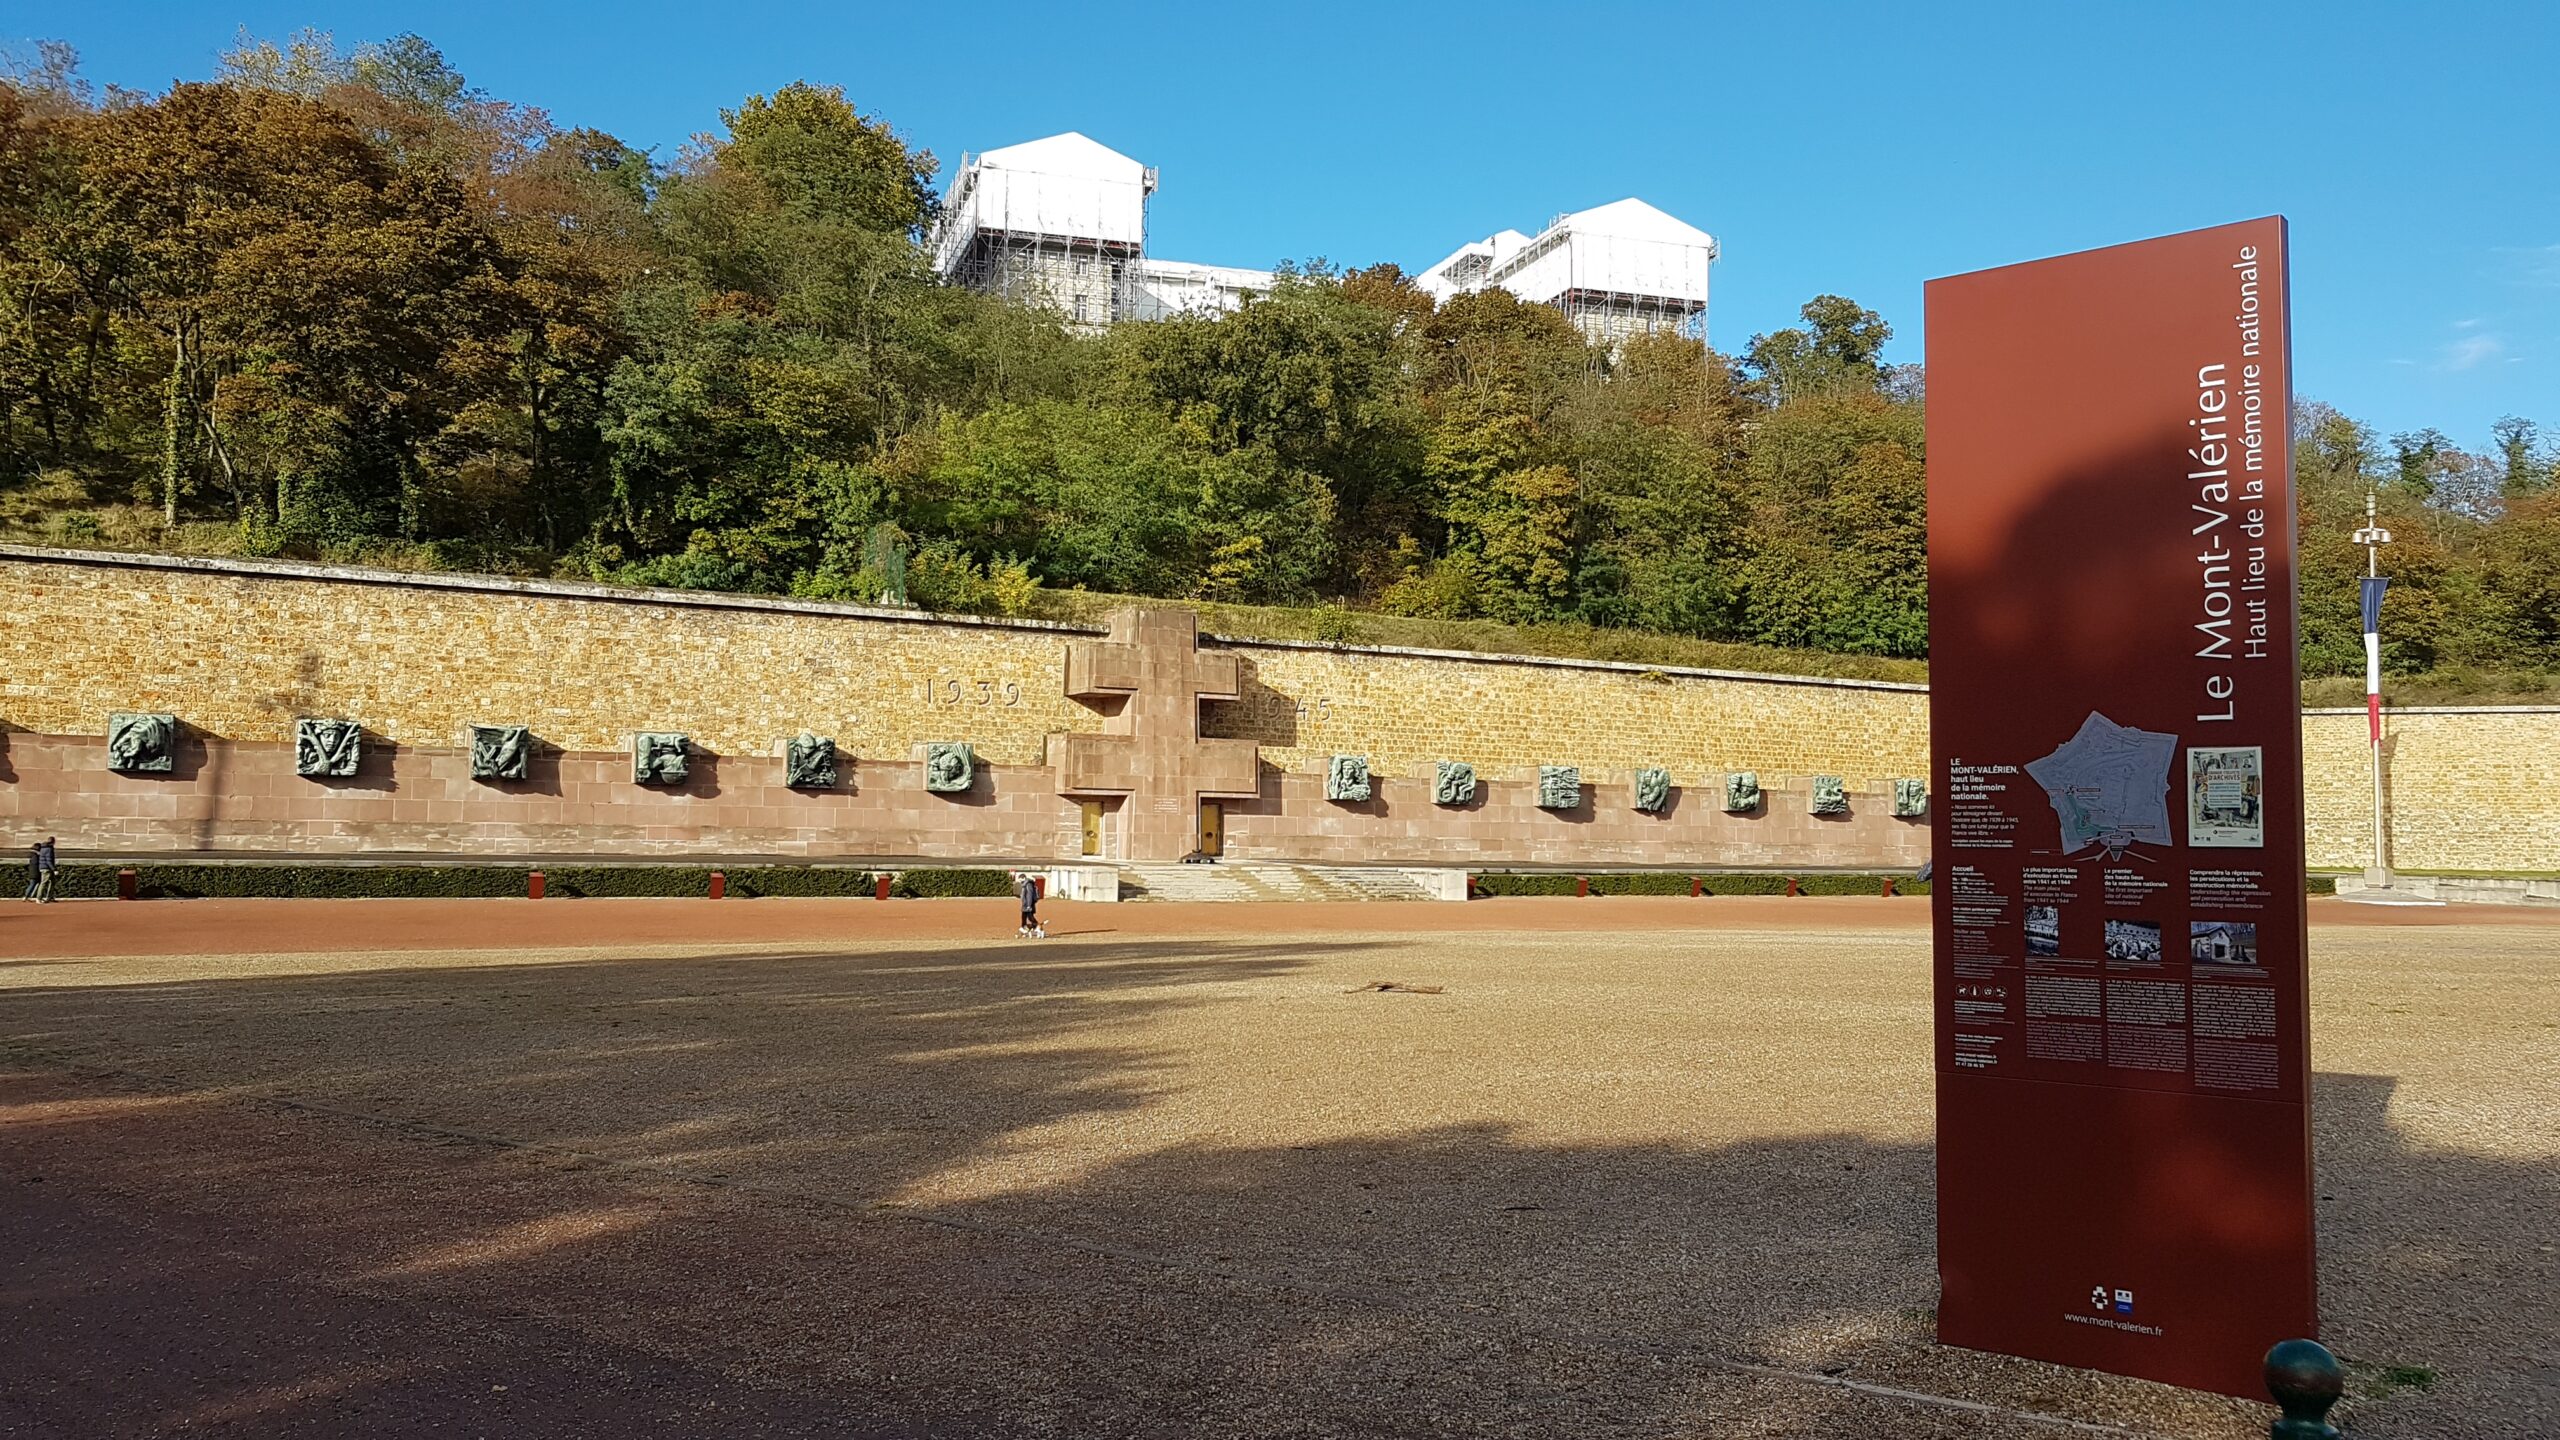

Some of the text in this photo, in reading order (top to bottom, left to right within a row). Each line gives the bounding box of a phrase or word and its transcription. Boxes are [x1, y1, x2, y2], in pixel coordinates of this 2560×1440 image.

[2233, 245, 2267, 658] Haut lieu de la mémoire nationale
[2187, 364, 2233, 721] Le Mont-Valérien
[927, 679, 1020, 706] 1939
[1252, 695, 1332, 721] 1945
[1951, 765, 2019, 774] MONT-VALÉRIEN,
[1951, 792, 1989, 800] nationale.
[2064, 1313, 2163, 1336] www.mont-valerien.fr
